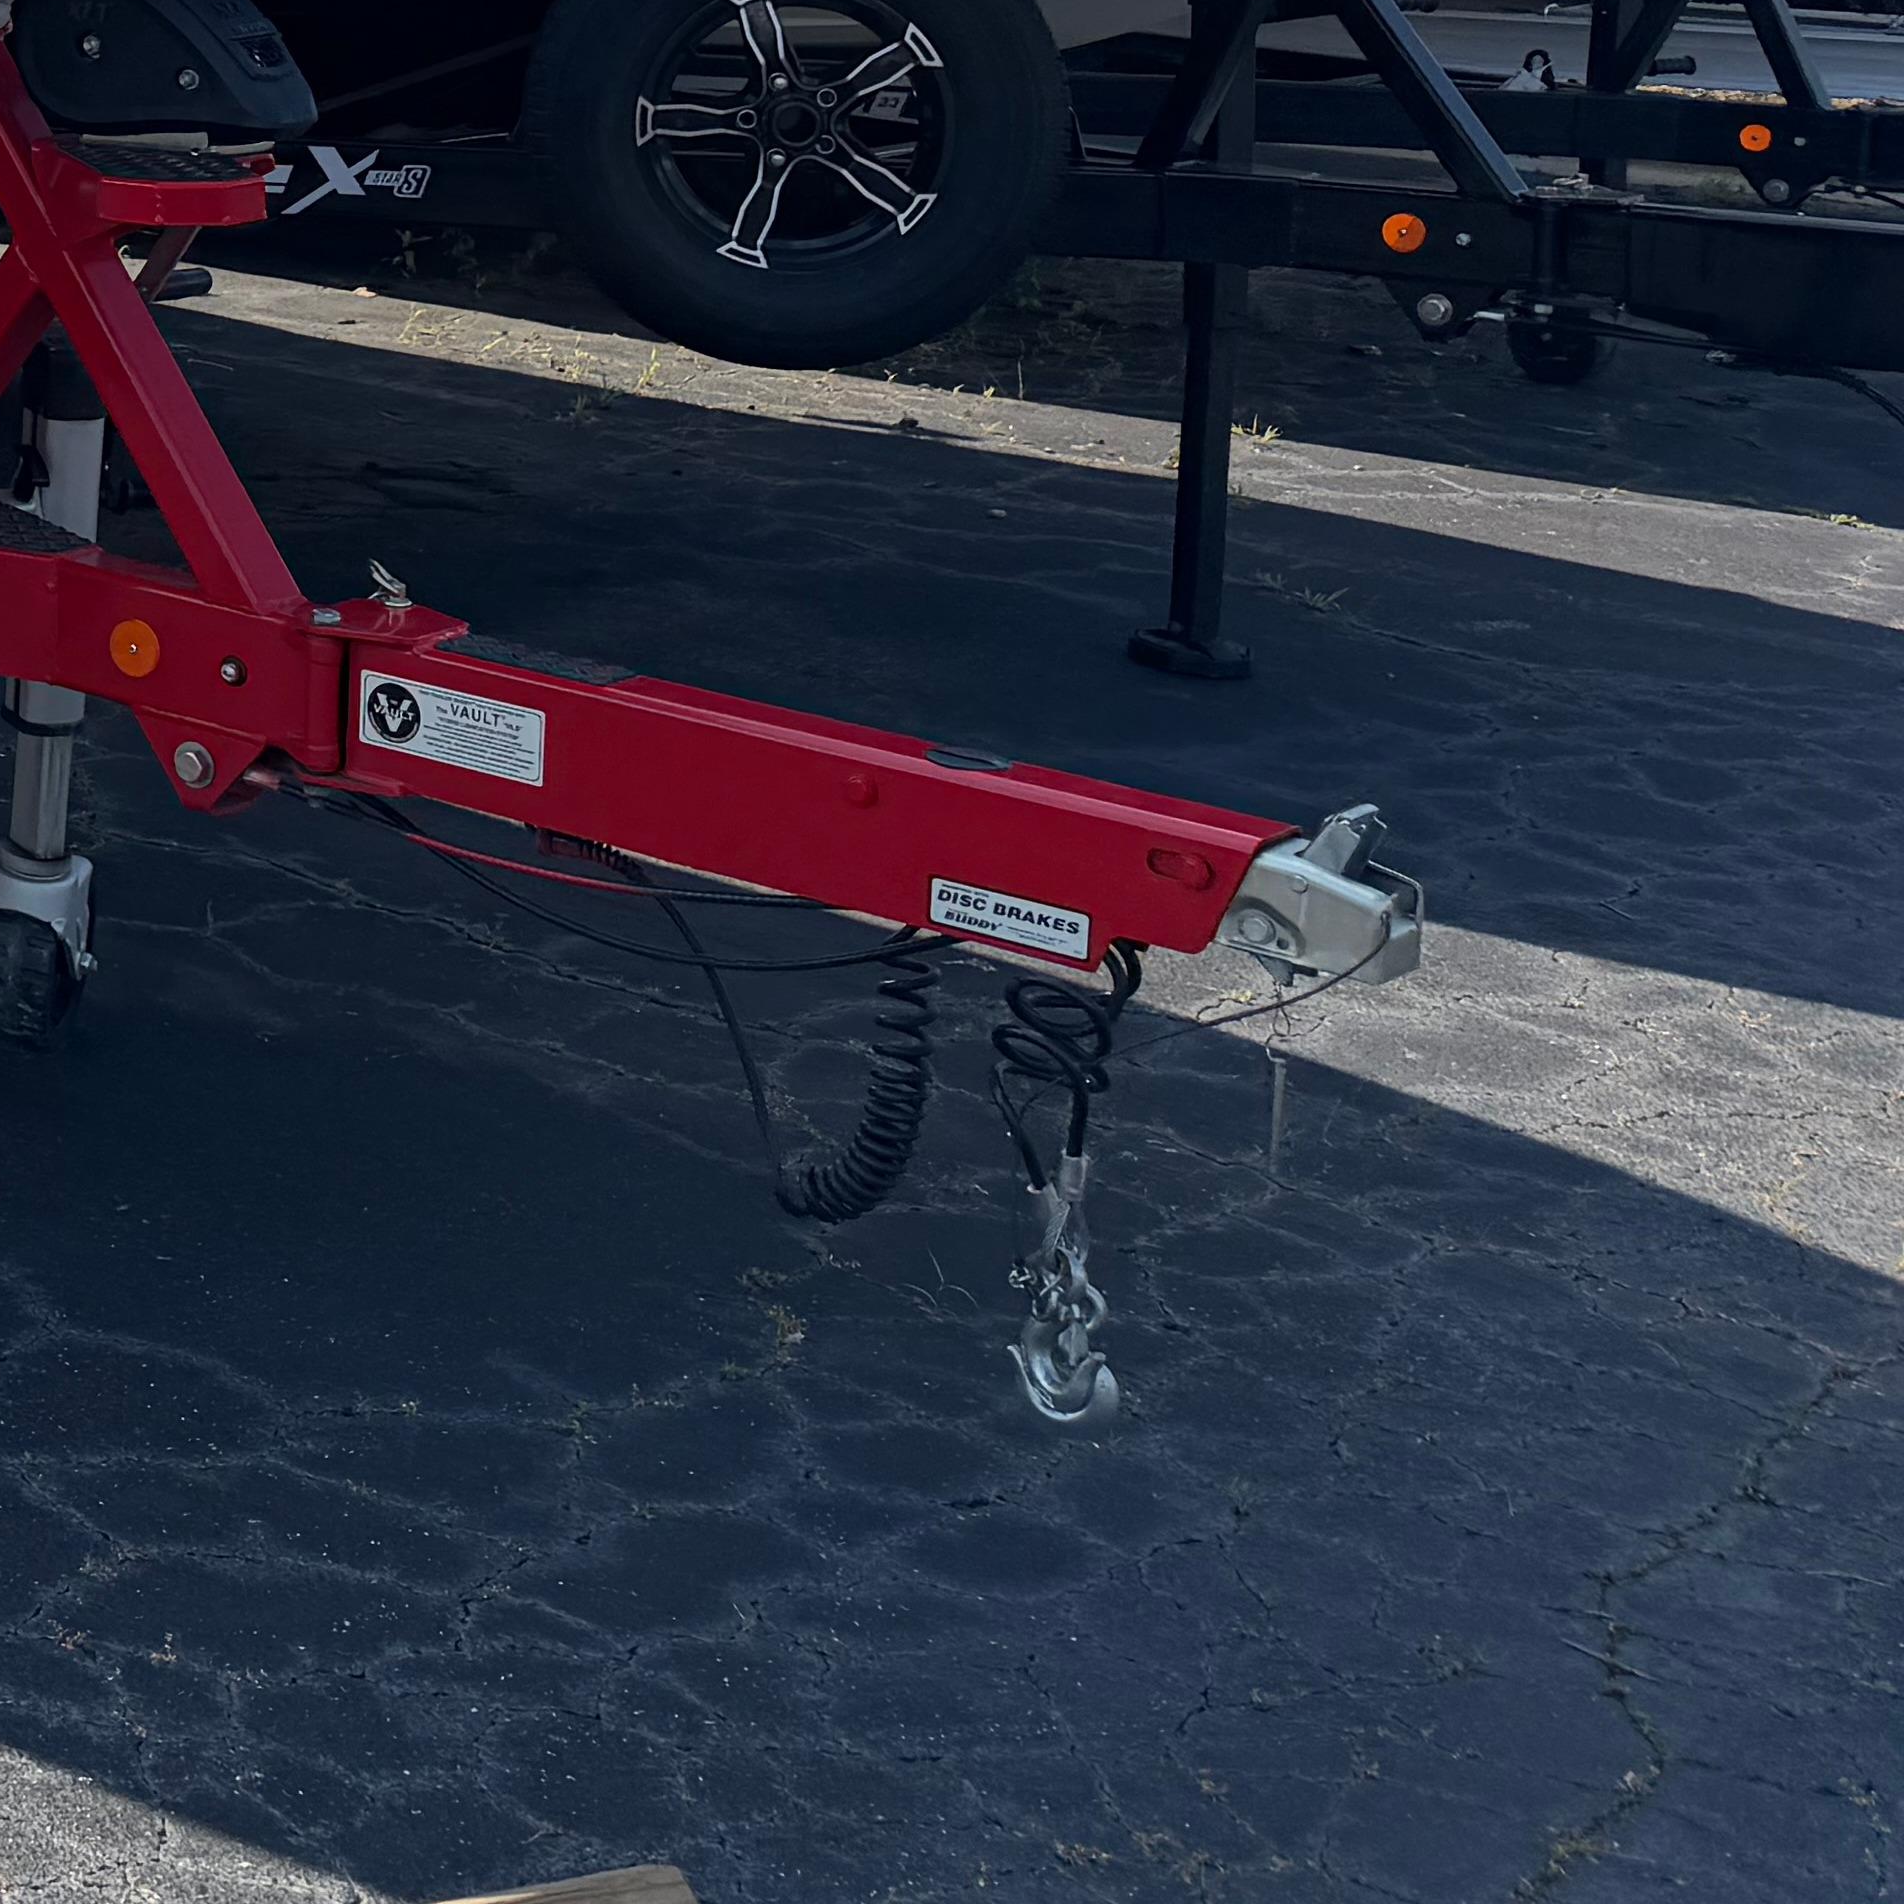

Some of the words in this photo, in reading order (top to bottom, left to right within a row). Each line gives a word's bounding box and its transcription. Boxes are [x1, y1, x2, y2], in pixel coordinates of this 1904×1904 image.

[450, 702, 500, 728] VAULT
[937, 888, 988, 912] DISC
[992, 902, 1080, 935] BRAKES
[943, 910, 1004, 932] BUDDY
